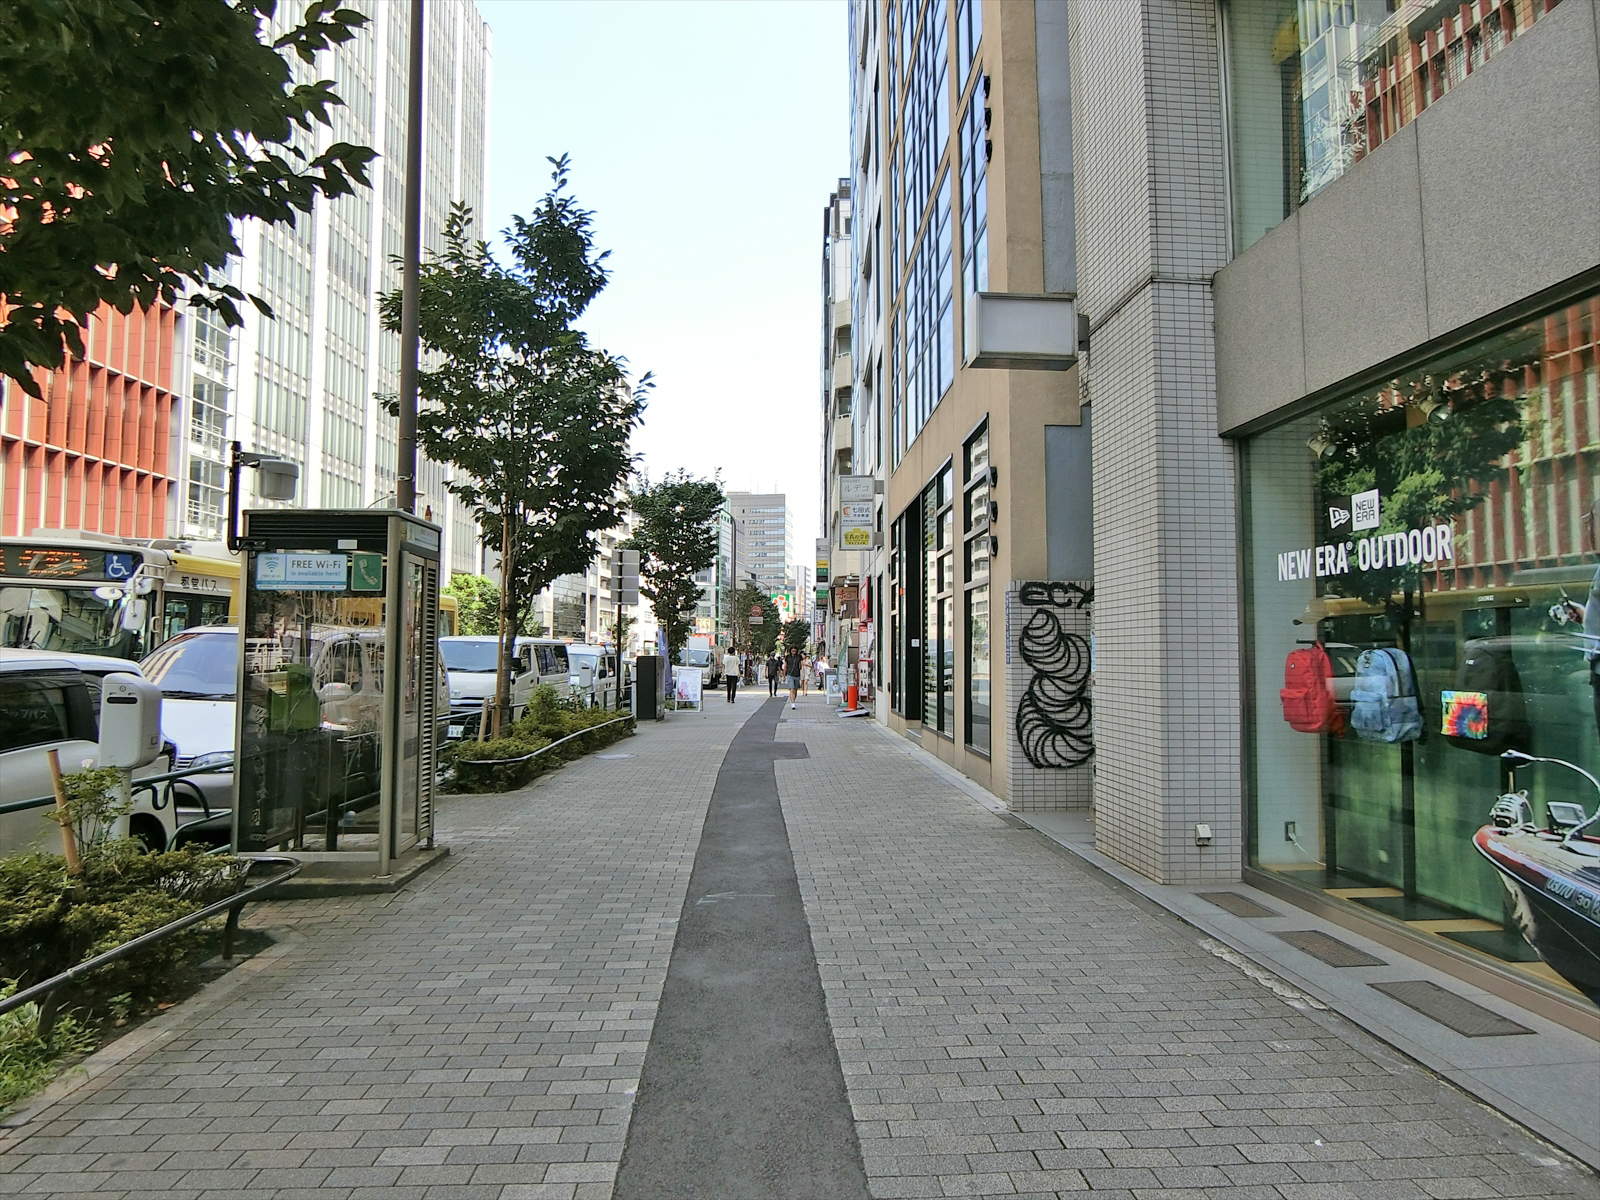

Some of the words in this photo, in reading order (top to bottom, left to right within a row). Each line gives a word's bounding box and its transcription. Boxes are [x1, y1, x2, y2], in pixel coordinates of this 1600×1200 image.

[843, 484, 869, 493] ルデコ
[1355, 498, 1375, 511] NEW
[1355, 510, 1375, 523] ERA
[1278, 548, 1312, 581] NEW
[1358, 524, 1453, 572] OUTDOOR
[291, 560, 313, 569] FREE
[316, 560, 341, 569] Wi-Fi
[180, 575, 219, 592] 都営バス
